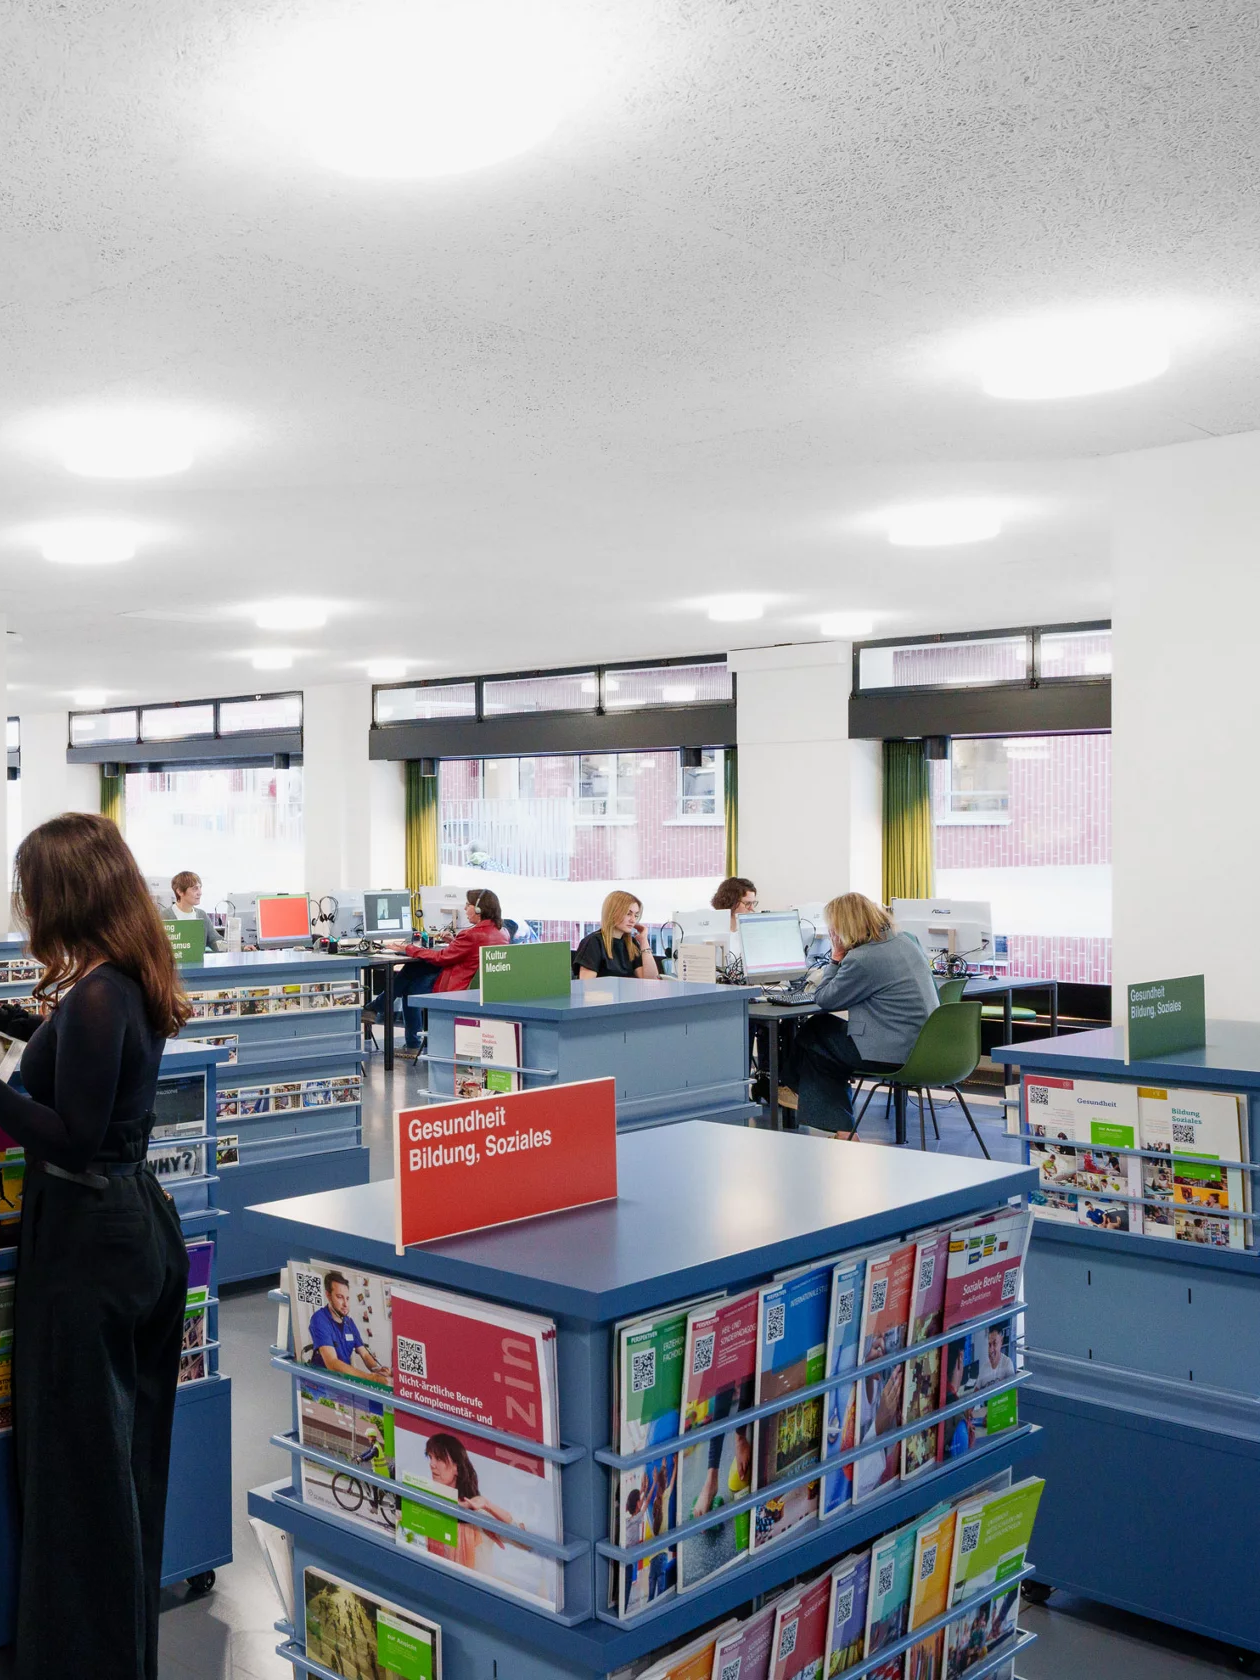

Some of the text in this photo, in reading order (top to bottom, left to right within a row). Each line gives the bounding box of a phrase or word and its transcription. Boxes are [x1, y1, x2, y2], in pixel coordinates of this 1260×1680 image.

[486, 951, 507, 961] Kultur
[486, 962, 510, 972] Medien
[1131, 986, 1165, 1002] Gesundheit
[1131, 1000, 1181, 1019] Bildung, Soziales
[1077, 1098, 1117, 1107] Gesundheit
[1172, 1108, 1200, 1118] Bildung
[1172, 1116, 1202, 1124] Soziales
[408, 1106, 506, 1142] Gesundheit
[409, 1128, 552, 1172] Bildung, Soziales
[963, 1272, 1002, 1296] Soziale Berufe
[399, 1373, 455, 1399] Nicht-ärztliche
[456, 1391, 483, 1409] Berufe
[400, 1387, 413, 1399] der
[414, 1390, 475, 1419] Komplementär-
[477, 1414, 493, 1426] und
